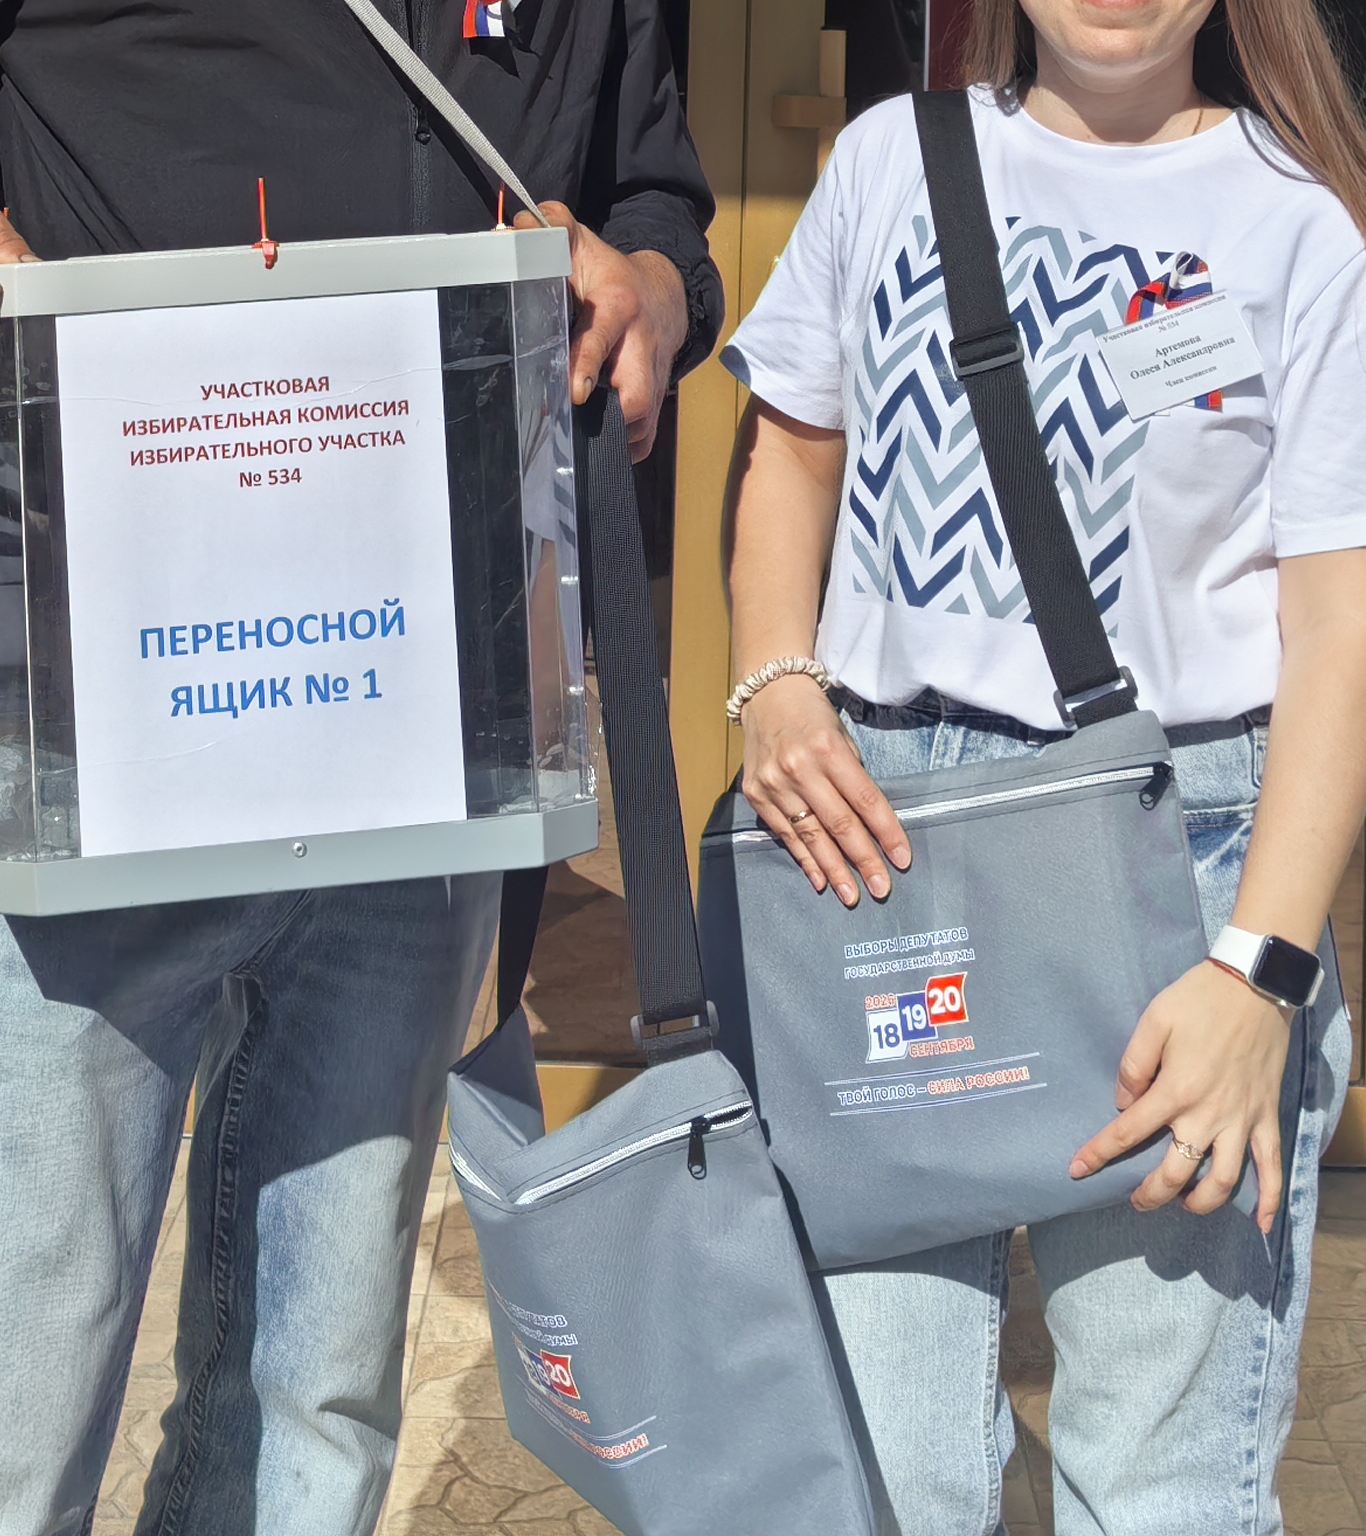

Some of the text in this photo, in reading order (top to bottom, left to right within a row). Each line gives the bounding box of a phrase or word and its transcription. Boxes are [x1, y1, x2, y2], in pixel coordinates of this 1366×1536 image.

[1130, 337, 1236, 380] Олеся Александровна
[1155, 335, 1202, 358] Артемова
[200, 375, 330, 402] УЧАСТКОВАЯ
[122, 399, 410, 437] ИЗБИРАТЕЛЬНАЯ КОМИССИЯ
[129, 429, 406, 467] ИЗБИРАТЕЛЬНОГО УЧАСТКА
[239, 467, 303, 489] № 534
[139, 597, 406, 660] ПЕРЕНОСНОЙ
[170, 668, 383, 719] ЯЩИК № 1
[844, 927, 969, 959] ВЫБОРЫ ДЕПУТАТОВ
[844, 948, 975, 979] ГОСУДАРСТВЕННОЙ ДУМЫ
[873, 985, 962, 1049] 18 19 20
[909, 1036, 976, 1058] СЕНТЯБРЯ
[837, 1085, 873, 1106] ТВОЙ
[873, 1083, 917, 1102] ГОЛОС
[926, 1078, 965, 1095] СИЛА
[965, 1066, 1030, 1089] РОССИИ!
[544, 1360, 571, 1387] 20
